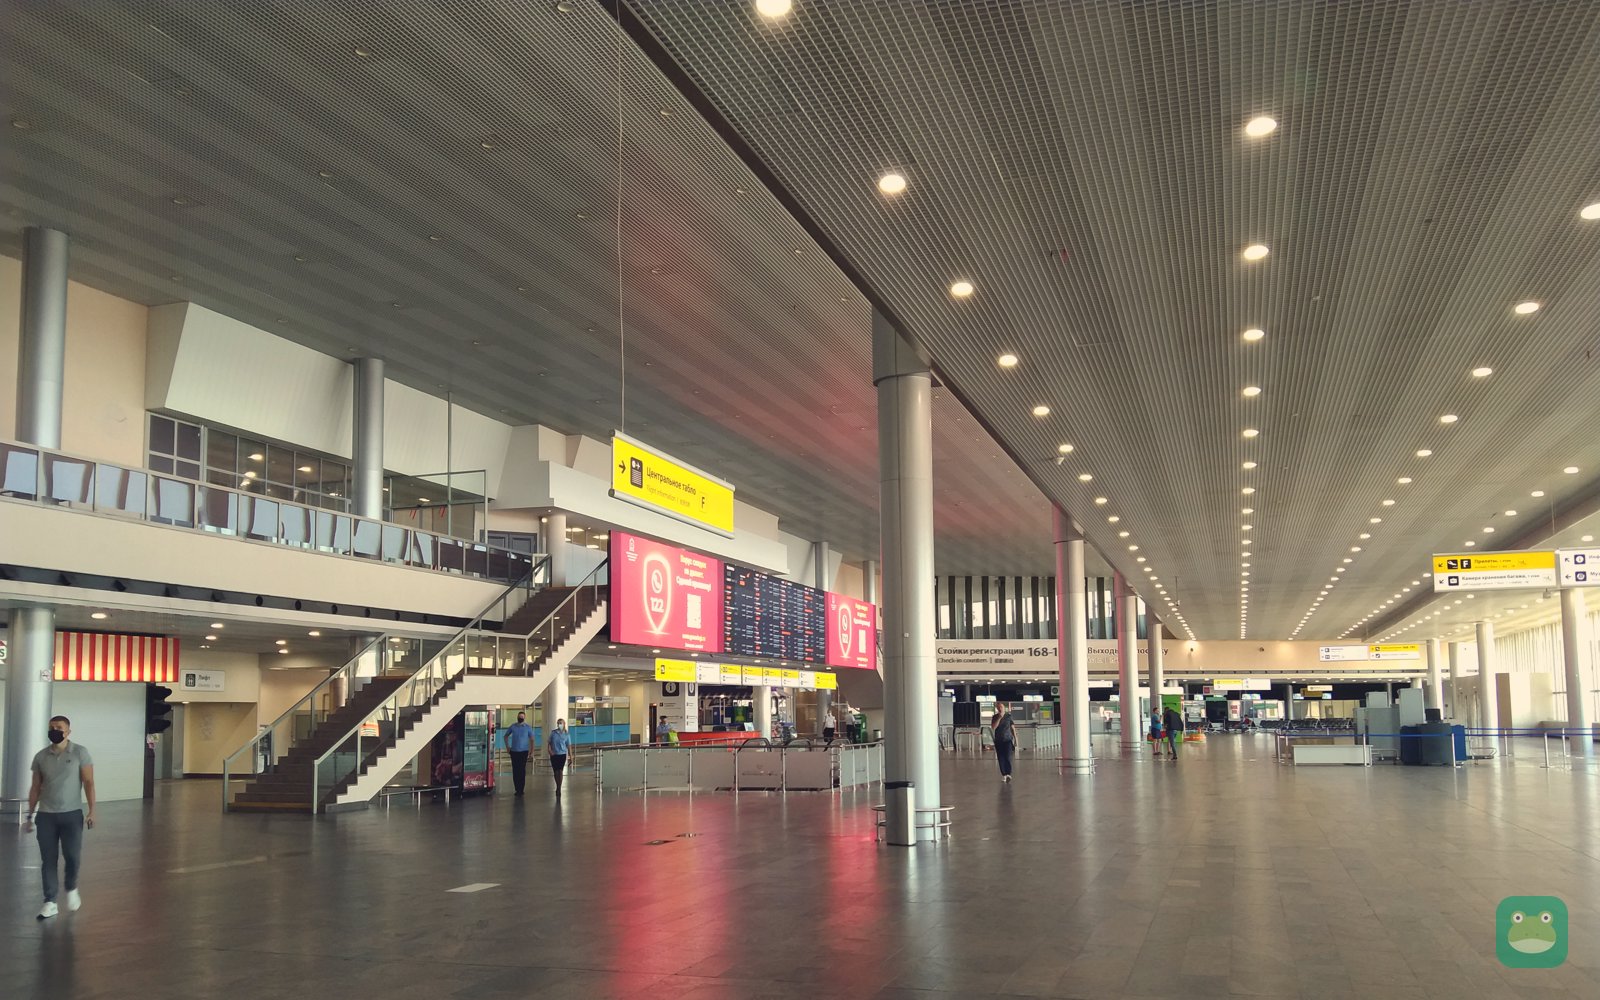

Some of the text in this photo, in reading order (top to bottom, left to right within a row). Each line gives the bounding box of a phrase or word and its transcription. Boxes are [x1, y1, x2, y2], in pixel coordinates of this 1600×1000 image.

[646, 466, 697, 495] Центральное табло
[701, 496, 706, 509] F
[937, 647, 1058, 657] Стойки регистрации 168-1
